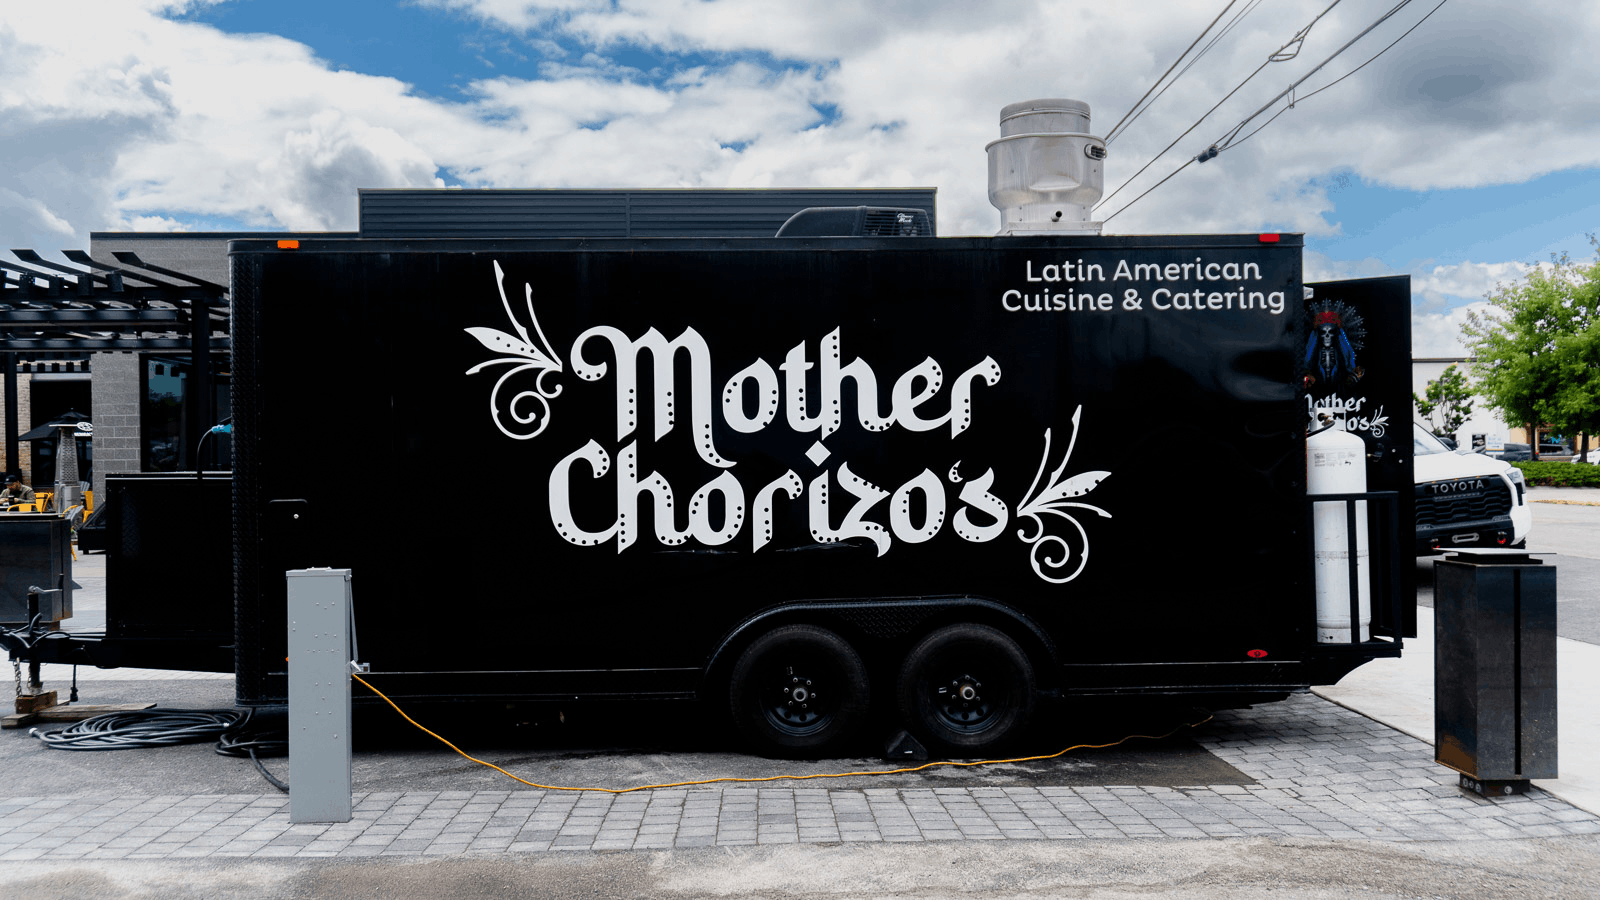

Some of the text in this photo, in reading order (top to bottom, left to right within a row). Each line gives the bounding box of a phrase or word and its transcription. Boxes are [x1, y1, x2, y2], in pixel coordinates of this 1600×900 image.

[1026, 257, 1263, 282] Latin American
[1001, 286, 1285, 315] Cuisine & Catering
[570, 325, 1002, 468] Mother
[548, 438, 1009, 558] Chorizo's
[1431, 479, 1484, 494] TOYOTA
